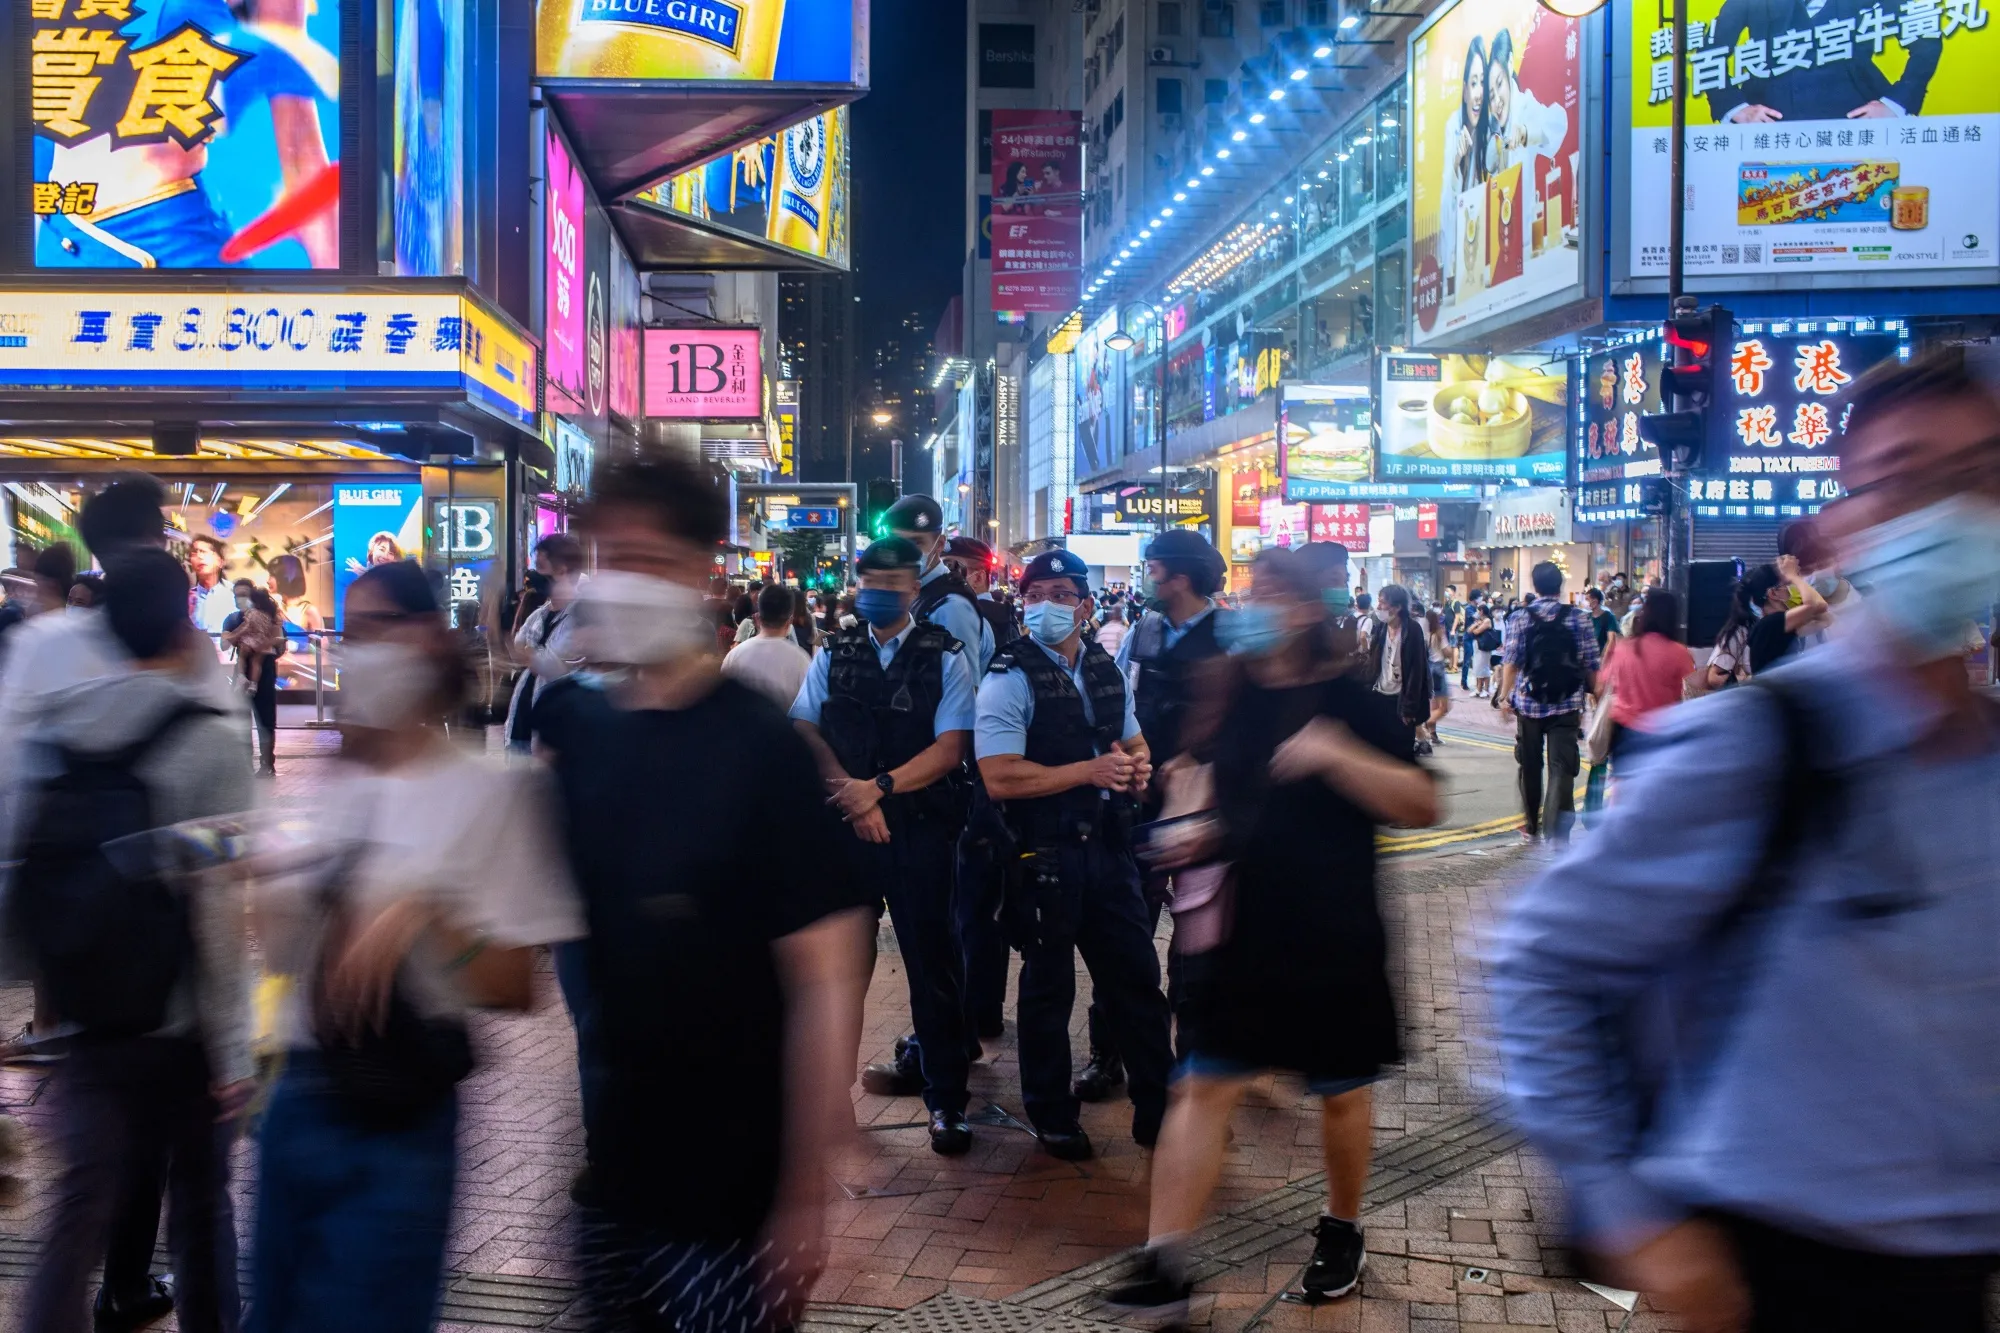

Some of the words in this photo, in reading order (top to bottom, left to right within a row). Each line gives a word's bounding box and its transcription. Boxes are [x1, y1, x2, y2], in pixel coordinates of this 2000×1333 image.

[667, 1, 730, 36] GIRL
[1652, 135, 1730, 154] 養安神
[1753, 129, 1876, 150] 維持心臟健康
[1900, 125, 1982, 145] 活血通絡
[1008, 225, 1028, 240] EF
[731, 344, 747, 394] 金百利
[1731, 340, 1852, 397] 香港
[999, 376, 1008, 417] FASHION
[780, 413, 794, 476] IKEA
[999, 419, 1008, 446] WALK
[1386, 464, 1402, 474] 1/F
[1405, 464, 1417, 474] JP
[1419, 464, 1448, 475] Plaza
[1762, 456, 1791, 473] TAX
[339, 489, 369, 500] BLUE
[371, 489, 401, 500] GIRL
[1308, 486, 1320, 496] JP
[1321, 486, 1346, 496] Plaza
[1126, 498, 1178, 514] LUSH
